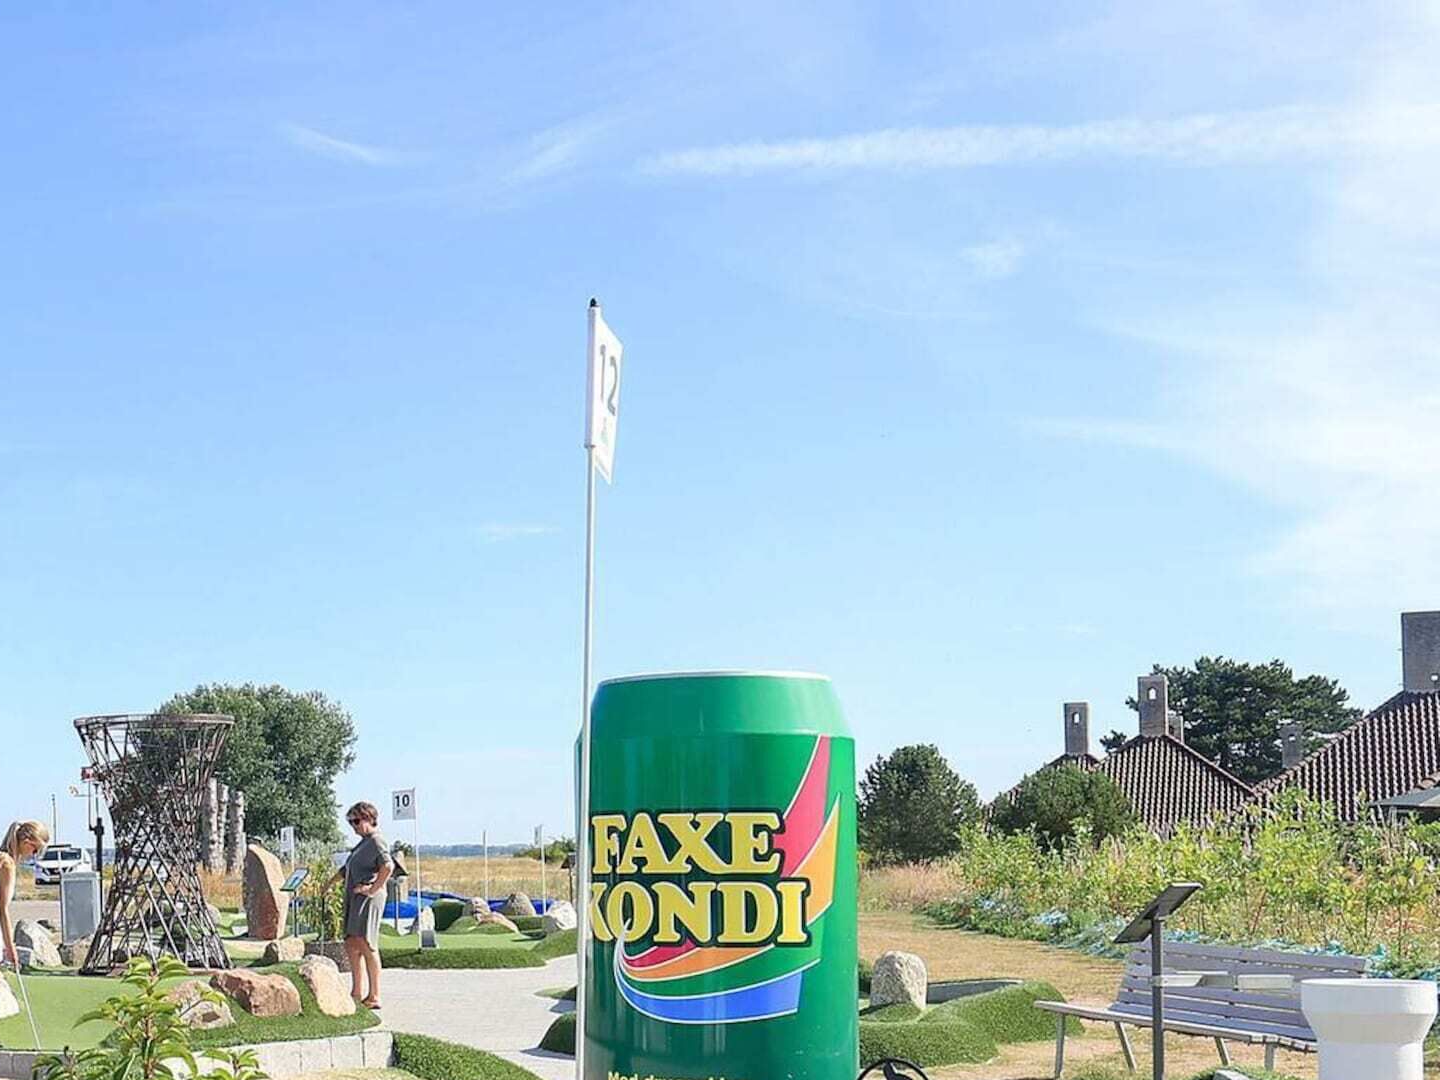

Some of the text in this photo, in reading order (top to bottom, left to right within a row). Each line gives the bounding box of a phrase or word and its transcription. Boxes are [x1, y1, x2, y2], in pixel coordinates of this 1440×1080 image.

[599, 344, 618, 416] 12
[394, 794, 410, 807] 10
[592, 813, 781, 874] FAXE
